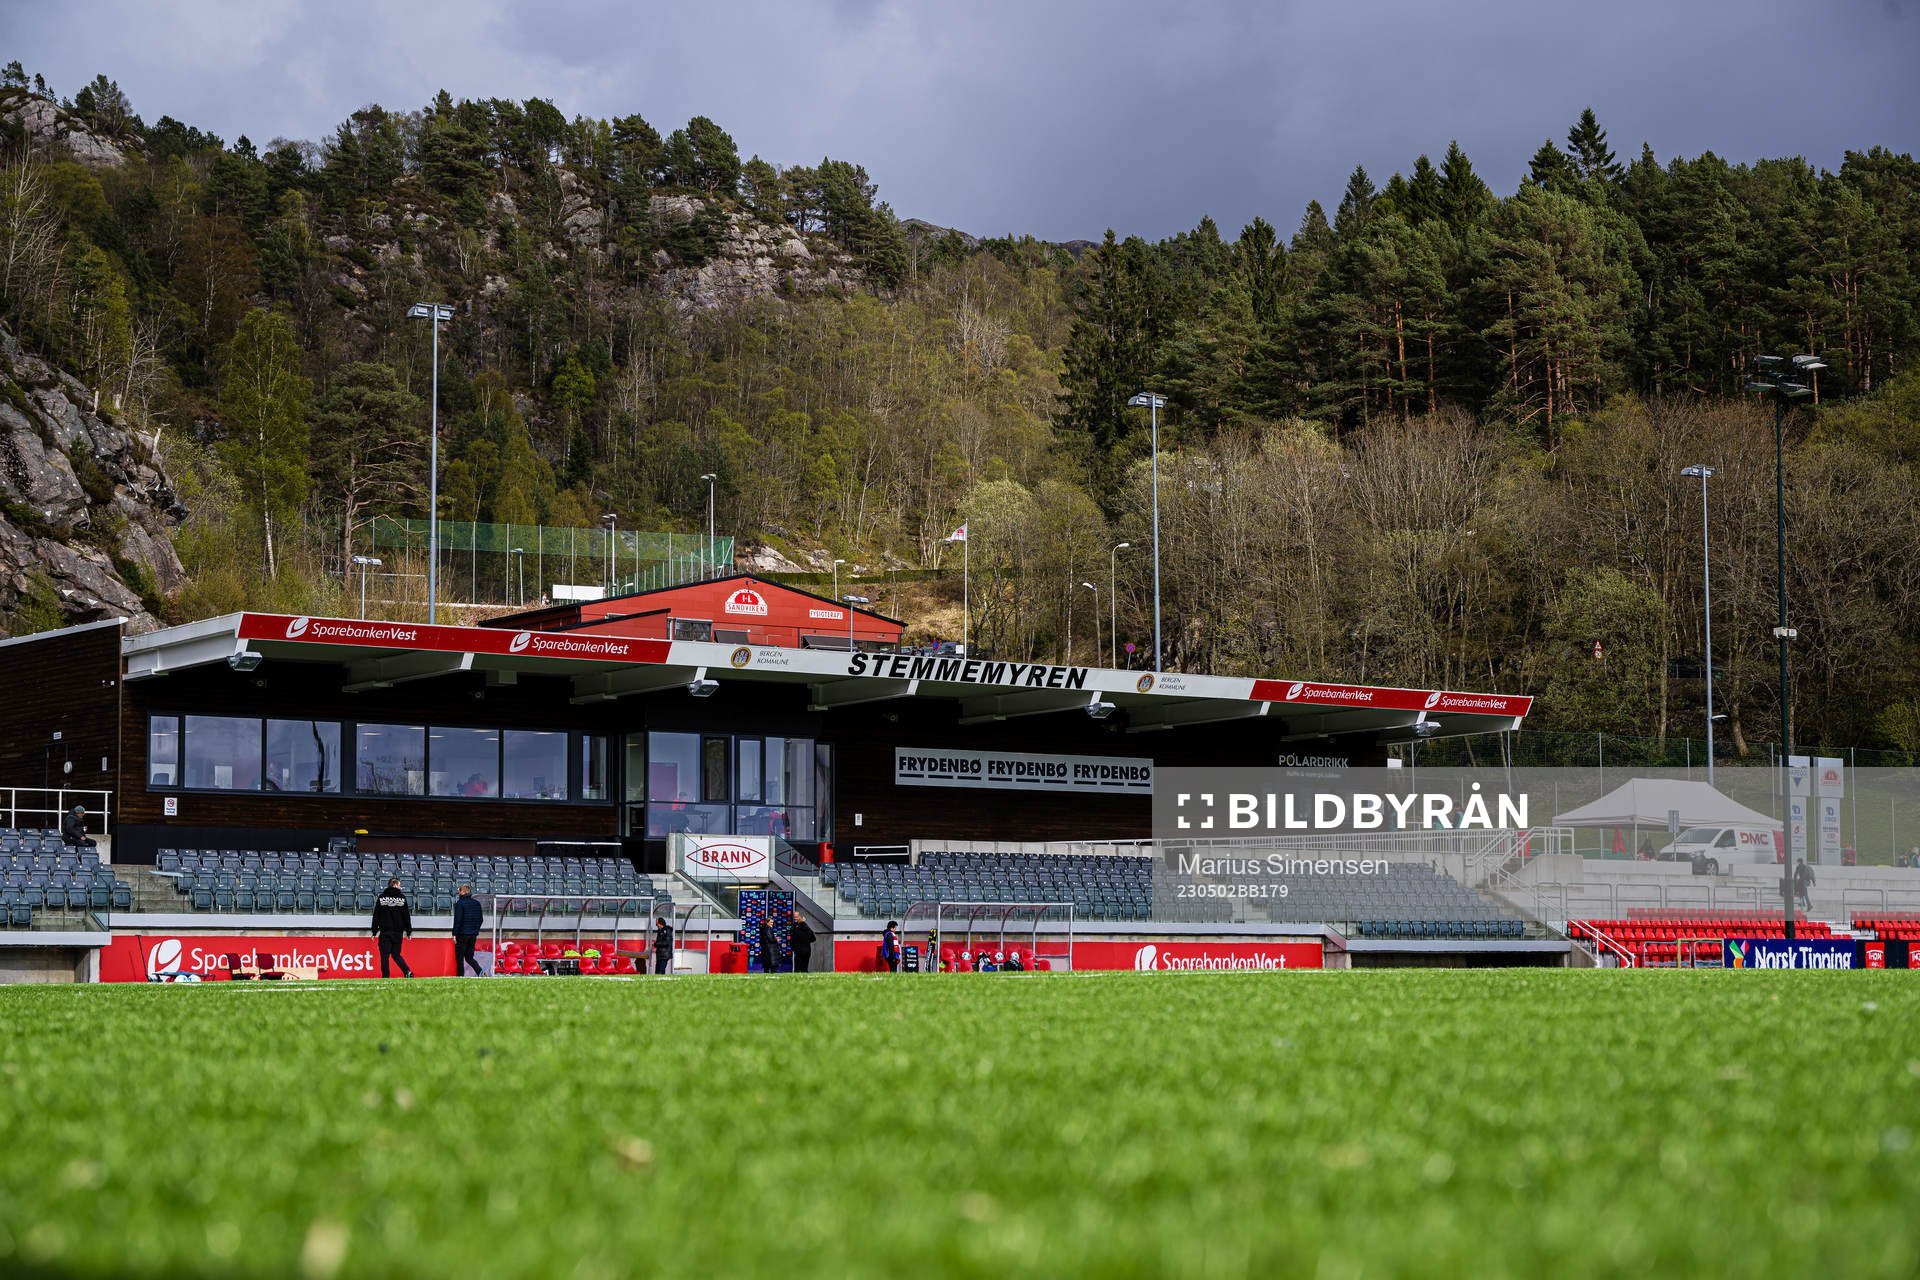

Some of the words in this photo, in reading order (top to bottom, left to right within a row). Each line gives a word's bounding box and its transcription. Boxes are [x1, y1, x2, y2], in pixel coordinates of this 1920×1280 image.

[728, 604, 765, 614] SANDVIKEN
[311, 621, 417, 641] SparebankenVest
[532, 636, 629, 656] SparebankenVest
[756, 657, 789, 666] KOMMUNE
[759, 650, 782, 658] BERGEN
[847, 652, 1088, 690] STEMMEMYREN
[1302, 686, 1374, 701] SparebankenVest
[1440, 694, 1507, 710] SparebankenVest
[899, 755, 982, 774] FRYDENBØ
[987, 759, 1067, 778] FRYDENBØ
[1073, 763, 1151, 781] FRYDENBØ
[1740, 832, 1768, 845] DMC
[702, 850, 751, 863] BRANN
